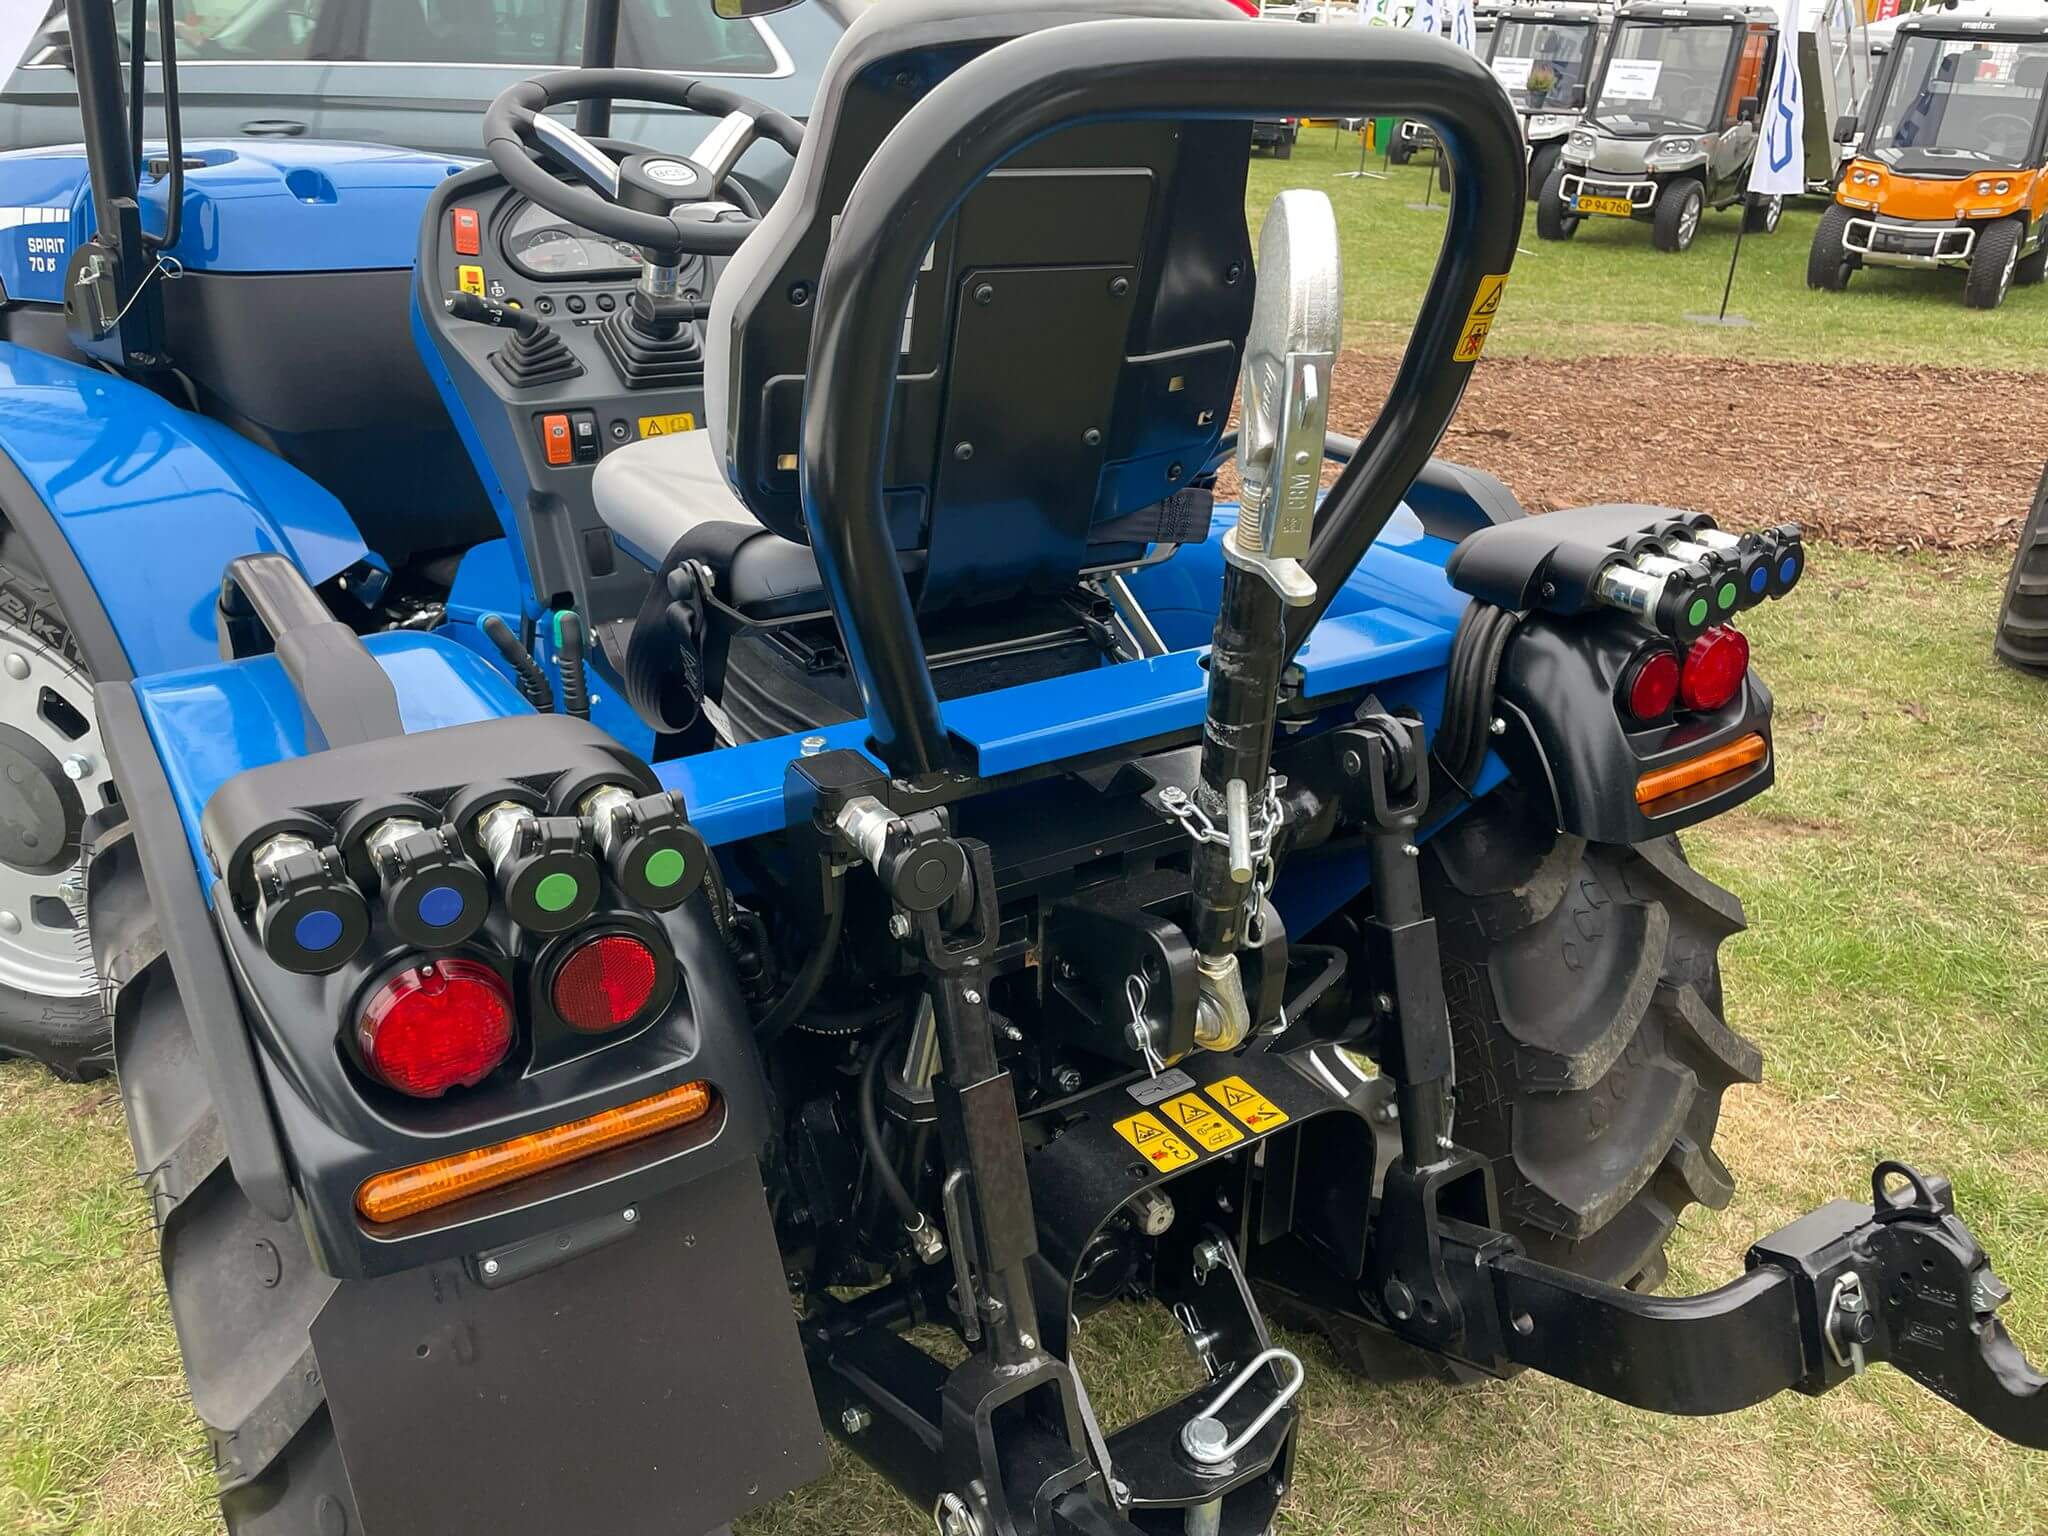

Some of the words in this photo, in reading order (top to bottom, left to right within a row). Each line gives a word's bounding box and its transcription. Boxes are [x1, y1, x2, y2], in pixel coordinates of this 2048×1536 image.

[1578, 198, 1592, 209] CP
[1609, 201, 1630, 214] 760
[27, 237, 65, 254] SPIRIT
[28, 256, 45, 273] 70
